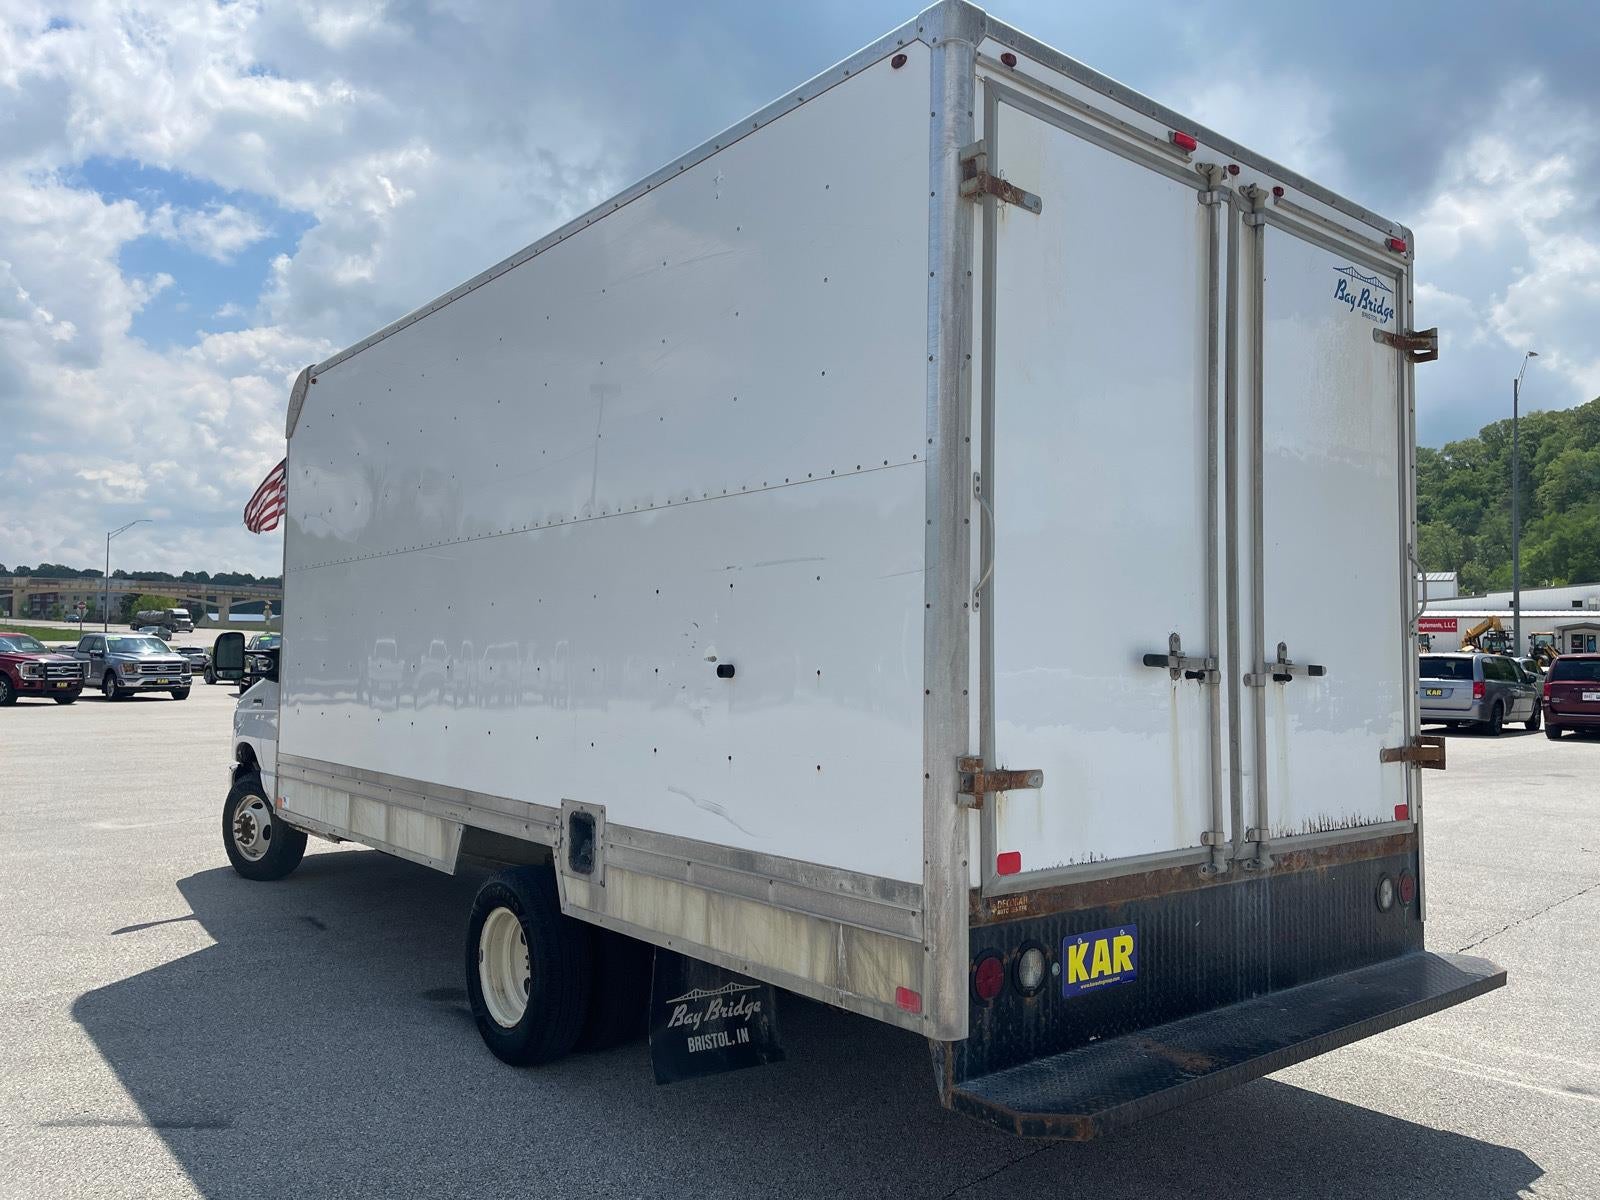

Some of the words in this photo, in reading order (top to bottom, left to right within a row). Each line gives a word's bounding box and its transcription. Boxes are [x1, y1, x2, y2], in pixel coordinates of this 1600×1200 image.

[1334, 278, 1357, 312] Bay
[1357, 287, 1394, 324] Bridge
[1419, 621, 1443, 629] mplements,
[1068, 934, 1134, 984] KAR
[667, 1003, 703, 1031] Bay
[703, 994, 761, 1021] Bridge
[687, 1031, 736, 1053] BRISTOL,
[737, 1027, 750, 1044] IN
